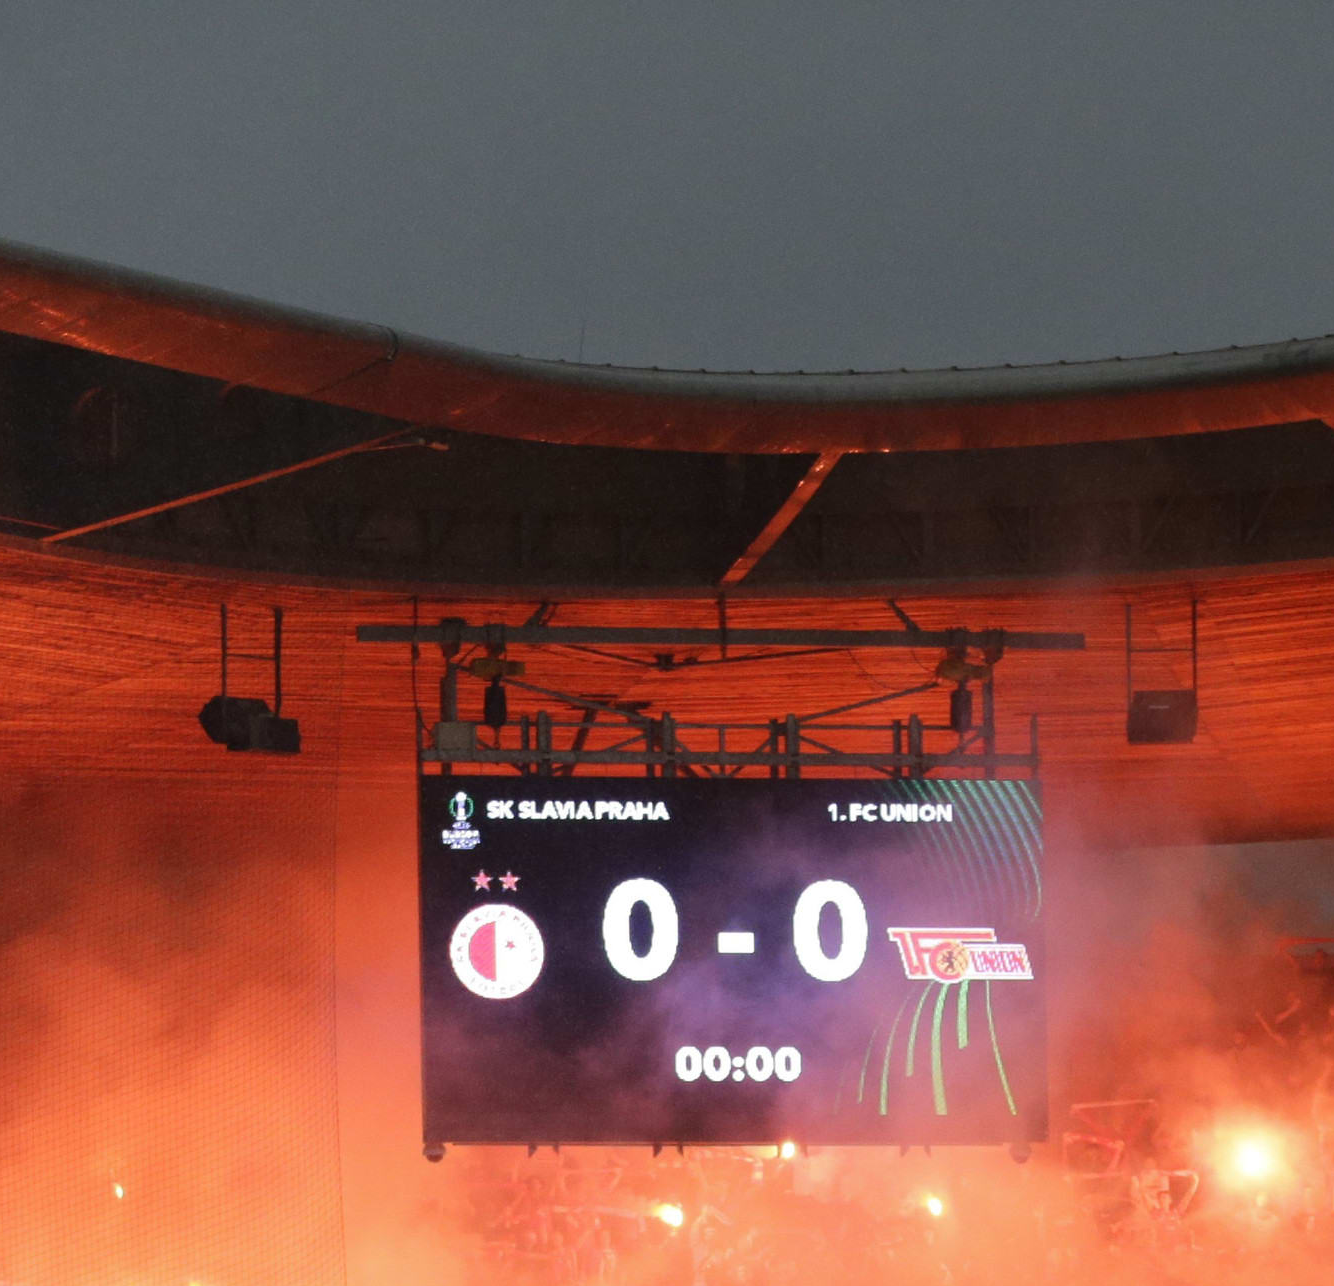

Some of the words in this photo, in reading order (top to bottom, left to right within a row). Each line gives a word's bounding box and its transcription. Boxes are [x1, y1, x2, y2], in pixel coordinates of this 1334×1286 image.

[486, 801, 514, 819] SK
[518, 801, 593, 819] SLAVIA
[594, 801, 670, 820] PRAHA
[827, 803, 847, 822] 1.
[849, 803, 878, 822] FC
[879, 803, 953, 822] UNION
[603, 878, 679, 981] 0
[793, 879, 868, 982] 0
[675, 1046, 802, 1082] 00:00
